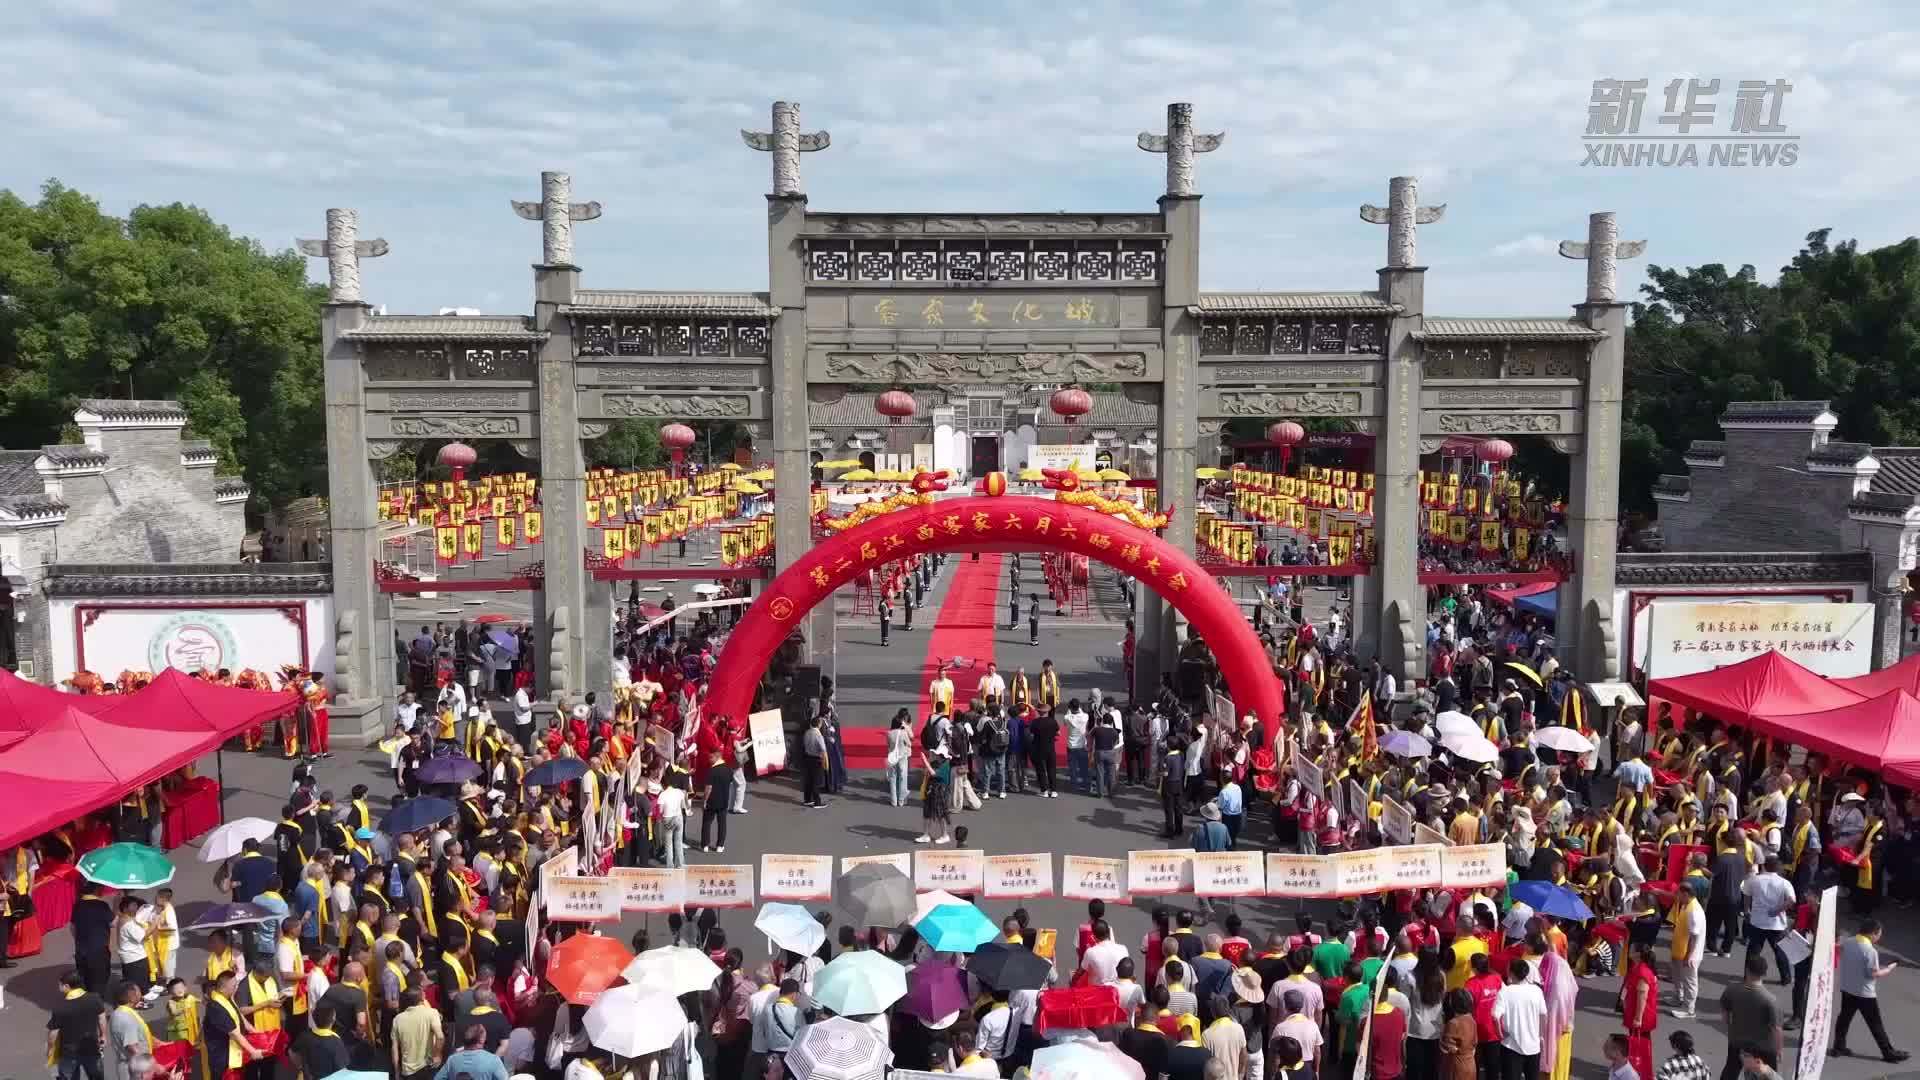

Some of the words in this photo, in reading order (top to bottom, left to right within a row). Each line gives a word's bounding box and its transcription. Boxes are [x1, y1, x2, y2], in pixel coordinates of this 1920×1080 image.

[1672, 639, 1856, 653] 第二届江西客家六月六晒谱大会
